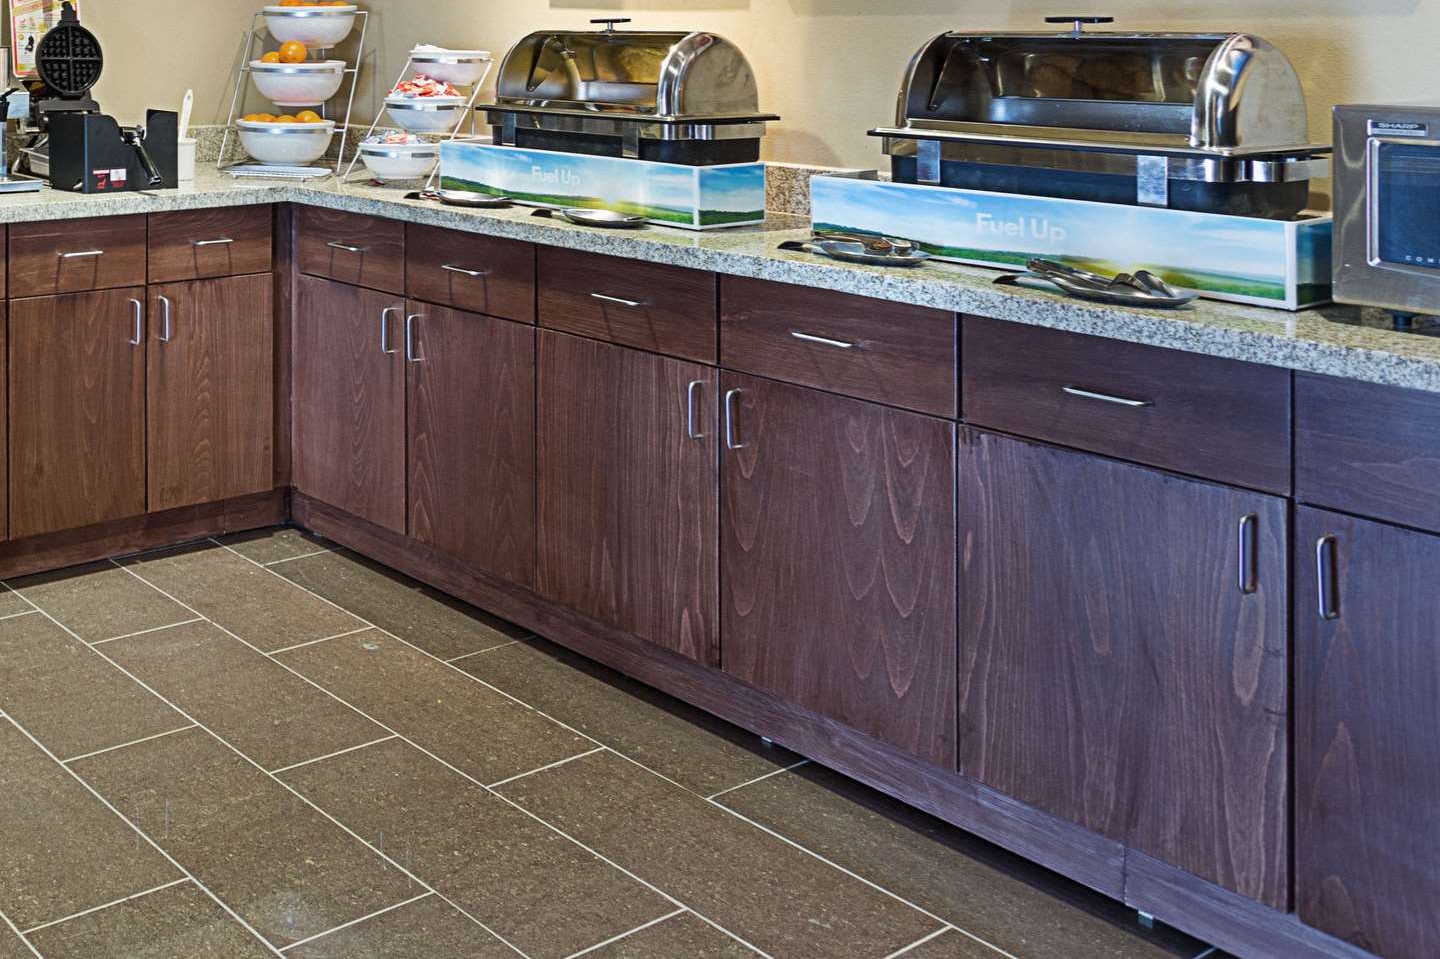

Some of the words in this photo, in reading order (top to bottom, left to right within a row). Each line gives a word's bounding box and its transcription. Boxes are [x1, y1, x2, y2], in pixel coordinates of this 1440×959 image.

[531, 165, 559, 183] Fuel
[560, 168, 581, 189] Up
[976, 212, 1025, 238] Fuel
[1029, 217, 1066, 244] Up
